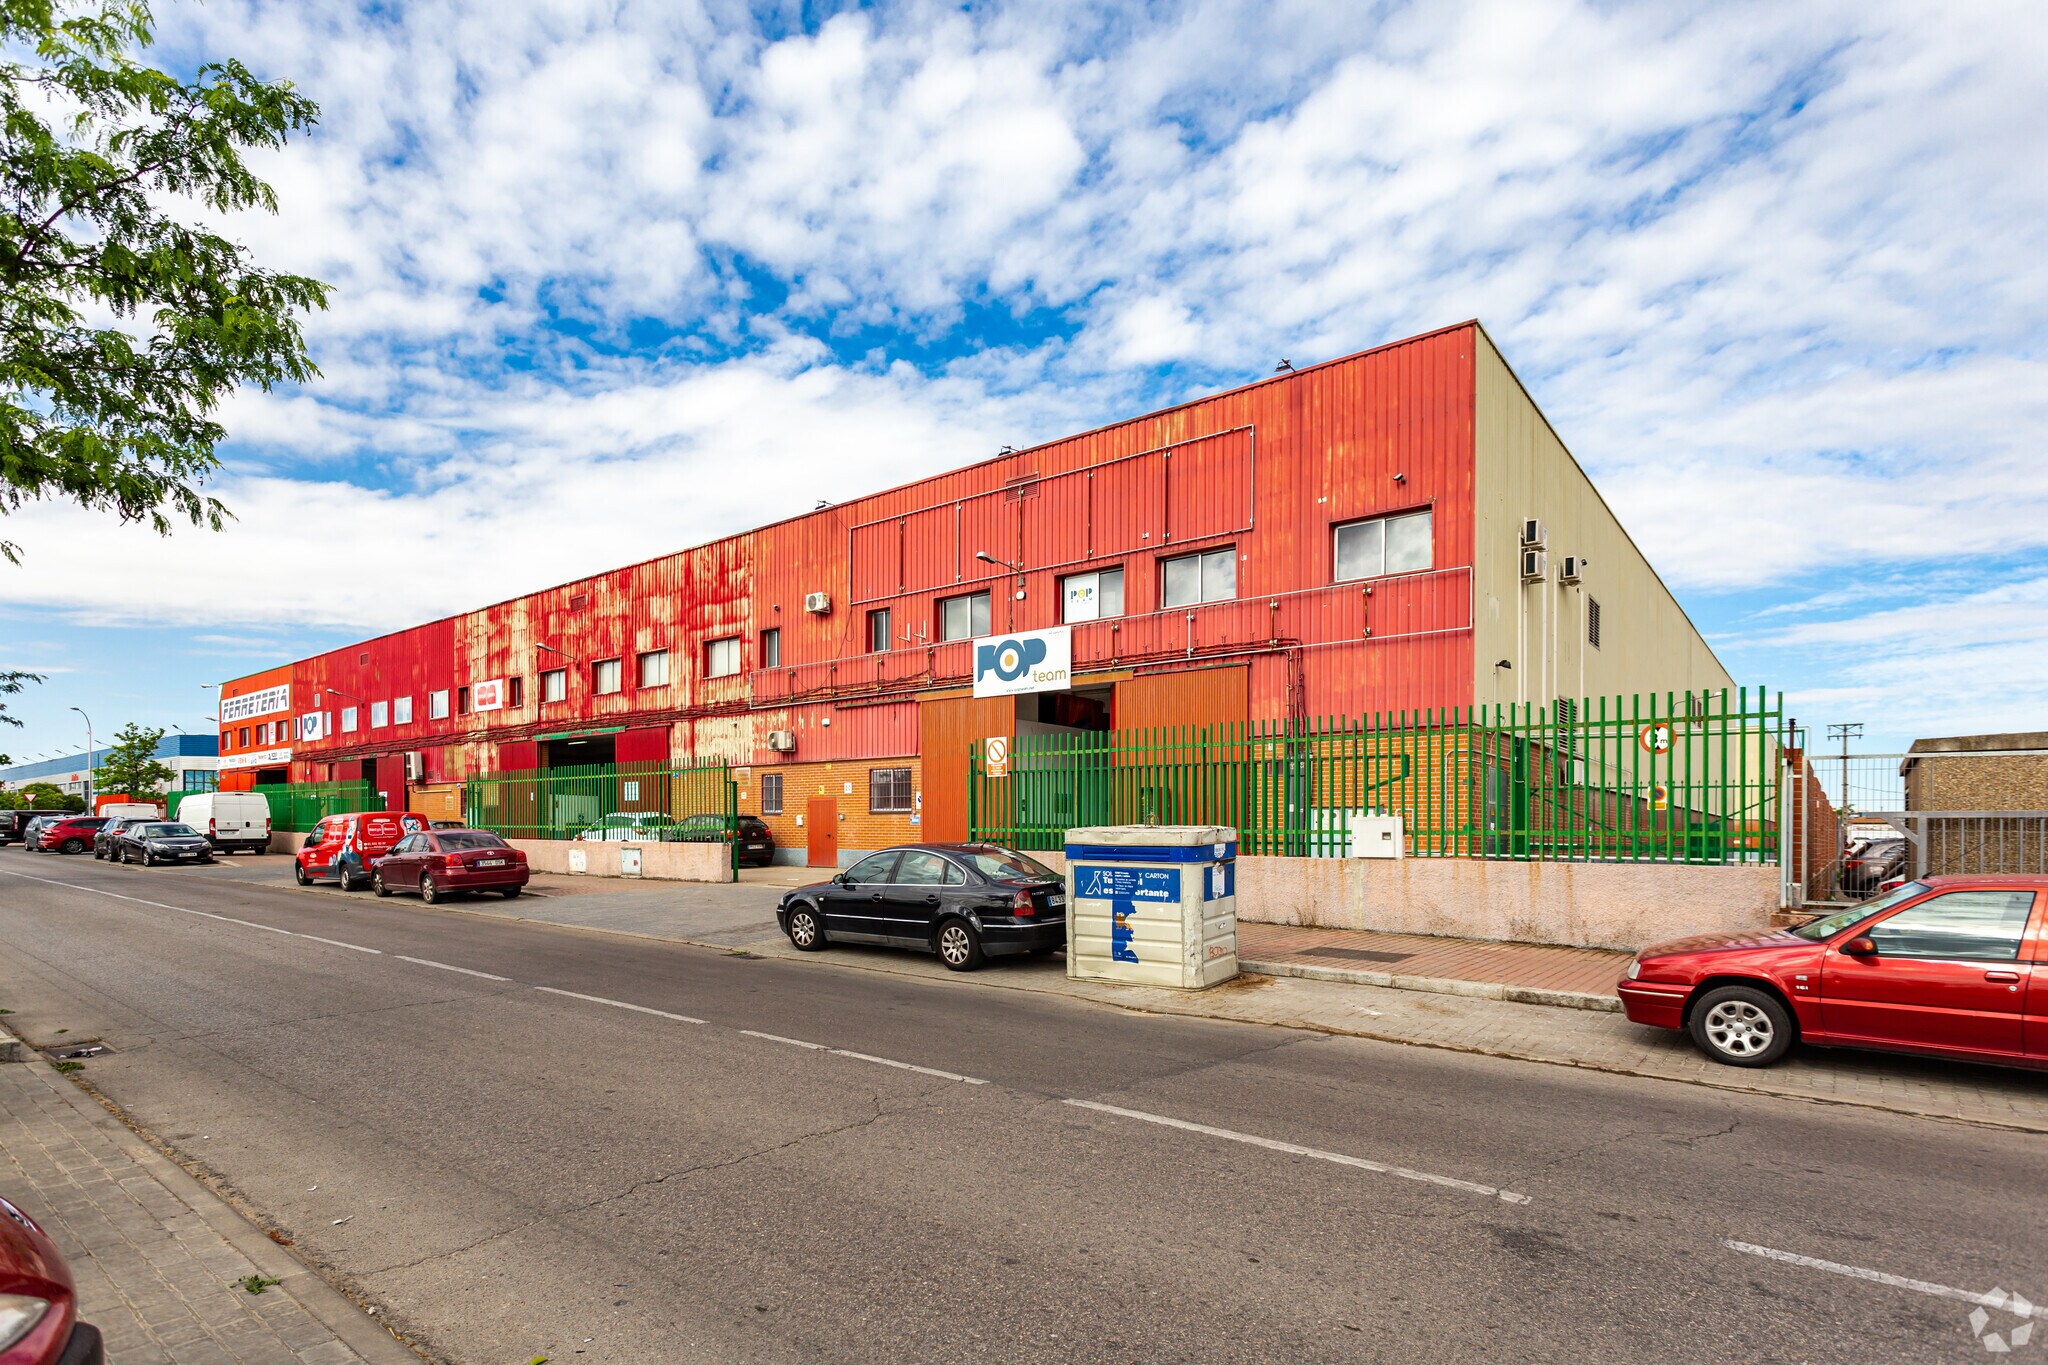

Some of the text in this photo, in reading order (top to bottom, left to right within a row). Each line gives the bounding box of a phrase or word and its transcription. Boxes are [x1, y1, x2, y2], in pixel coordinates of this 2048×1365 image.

[1070, 588, 1092, 600] POP
[978, 638, 1047, 683] POP
[1033, 669, 1067, 683] team
[223, 688, 288, 720] FERRETERIA
[1103, 876, 1113, 884] Tu
[1135, 888, 1169, 898] ortante
